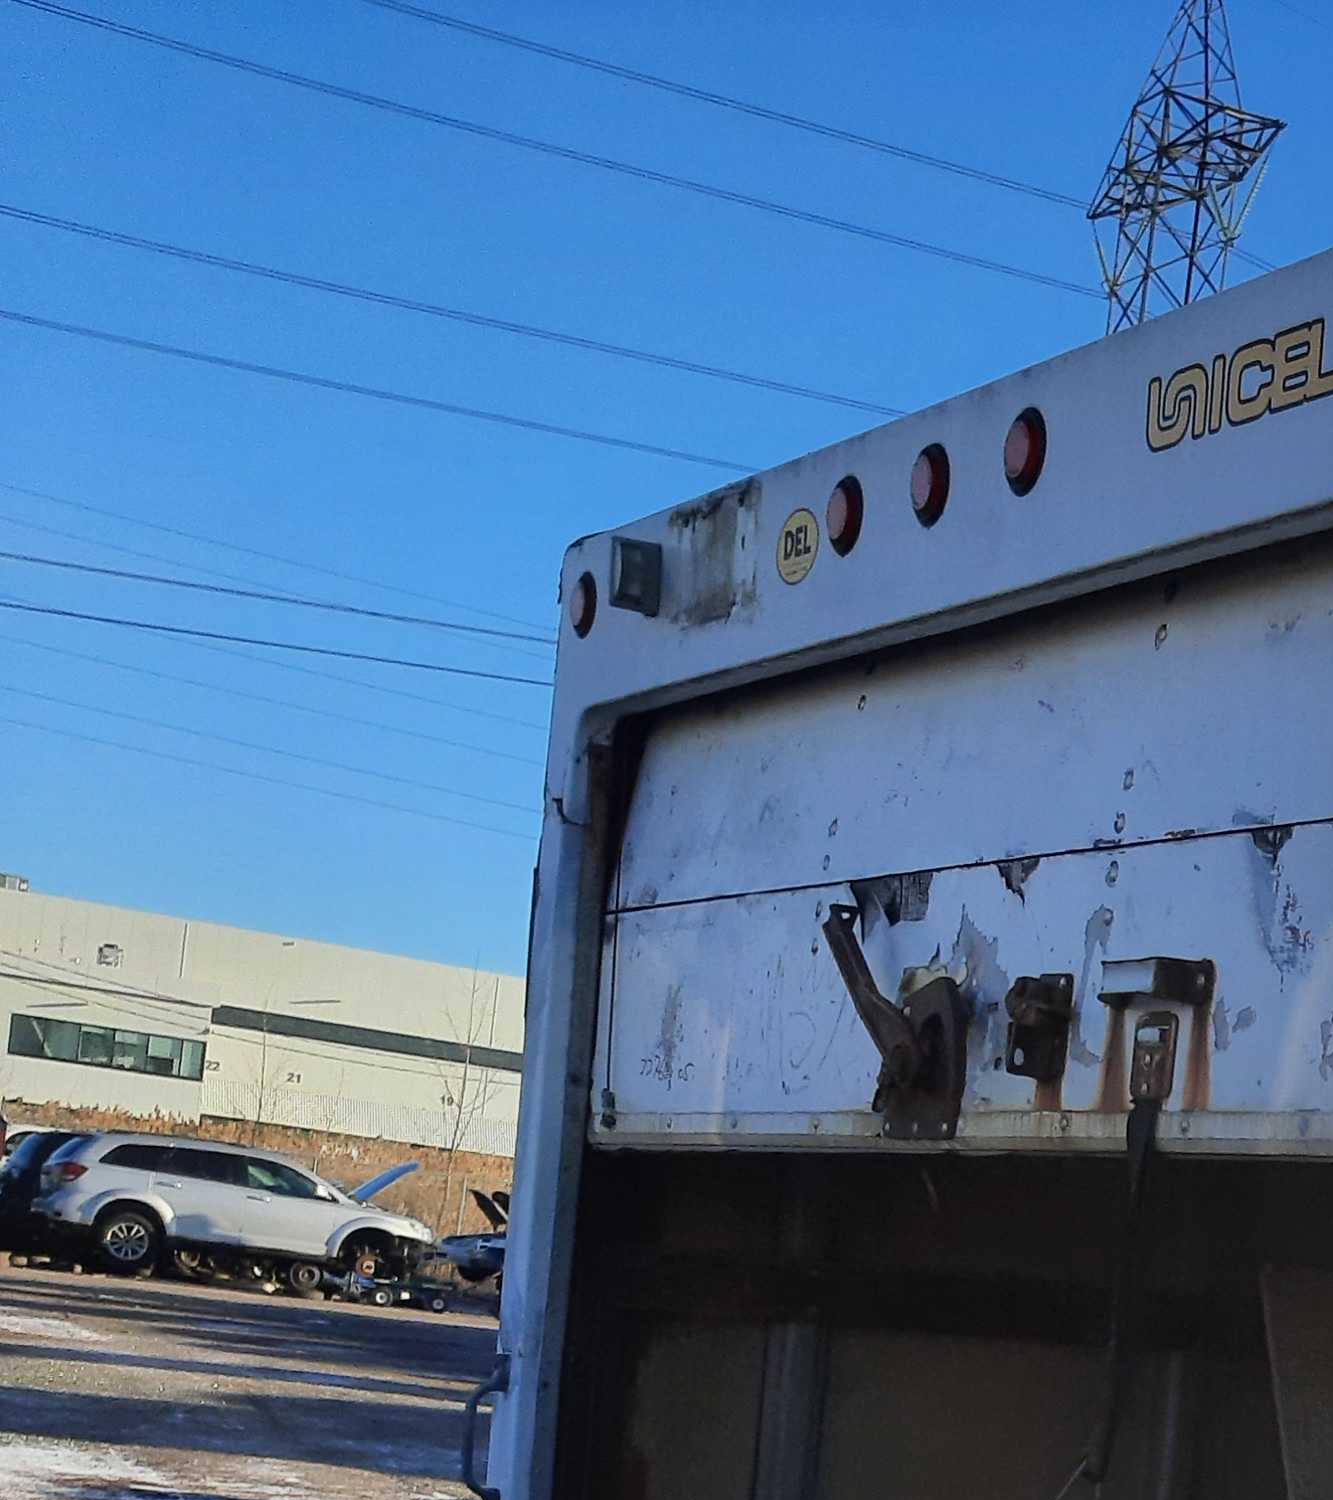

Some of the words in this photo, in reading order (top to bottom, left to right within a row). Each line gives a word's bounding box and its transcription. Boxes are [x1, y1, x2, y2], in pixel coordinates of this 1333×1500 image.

[783, 524, 811, 561] DEL
[206, 1060, 221, 1072] 22
[287, 1072, 302, 1084] 21
